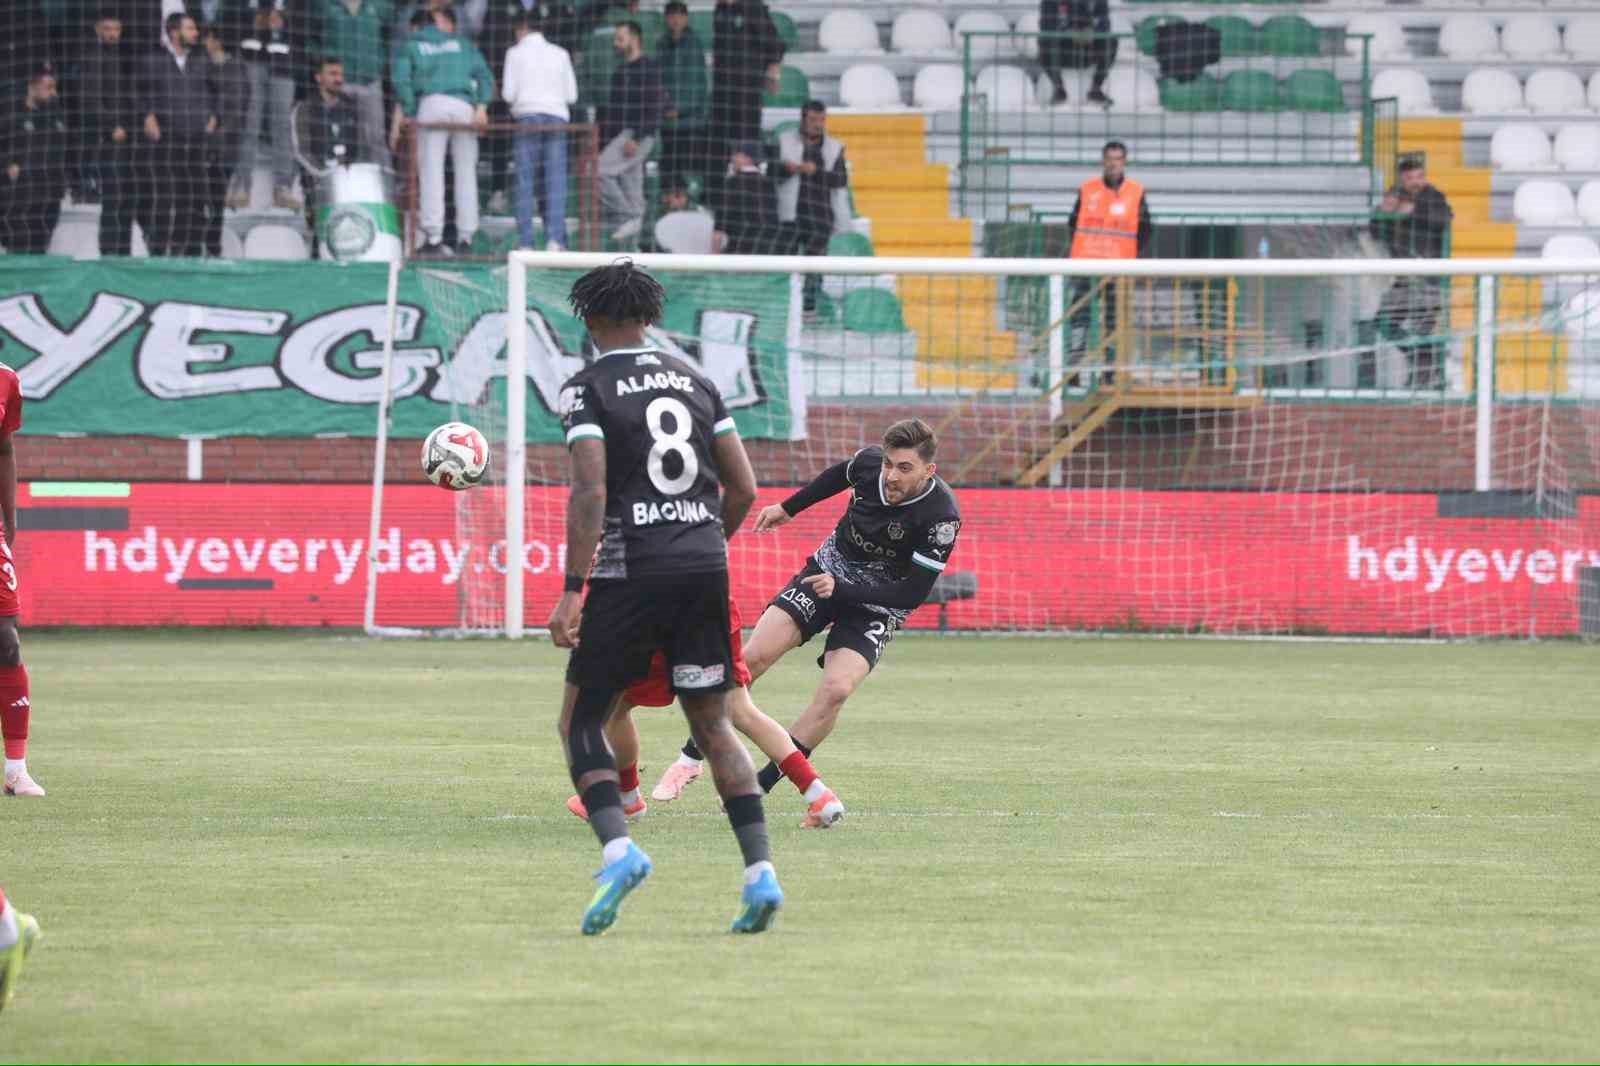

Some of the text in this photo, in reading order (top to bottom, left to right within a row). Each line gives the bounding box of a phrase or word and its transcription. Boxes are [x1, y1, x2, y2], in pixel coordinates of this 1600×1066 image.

[616, 370, 694, 396] ALAGÖZ
[645, 396, 698, 495] 8
[632, 500, 715, 525] BACUNA
